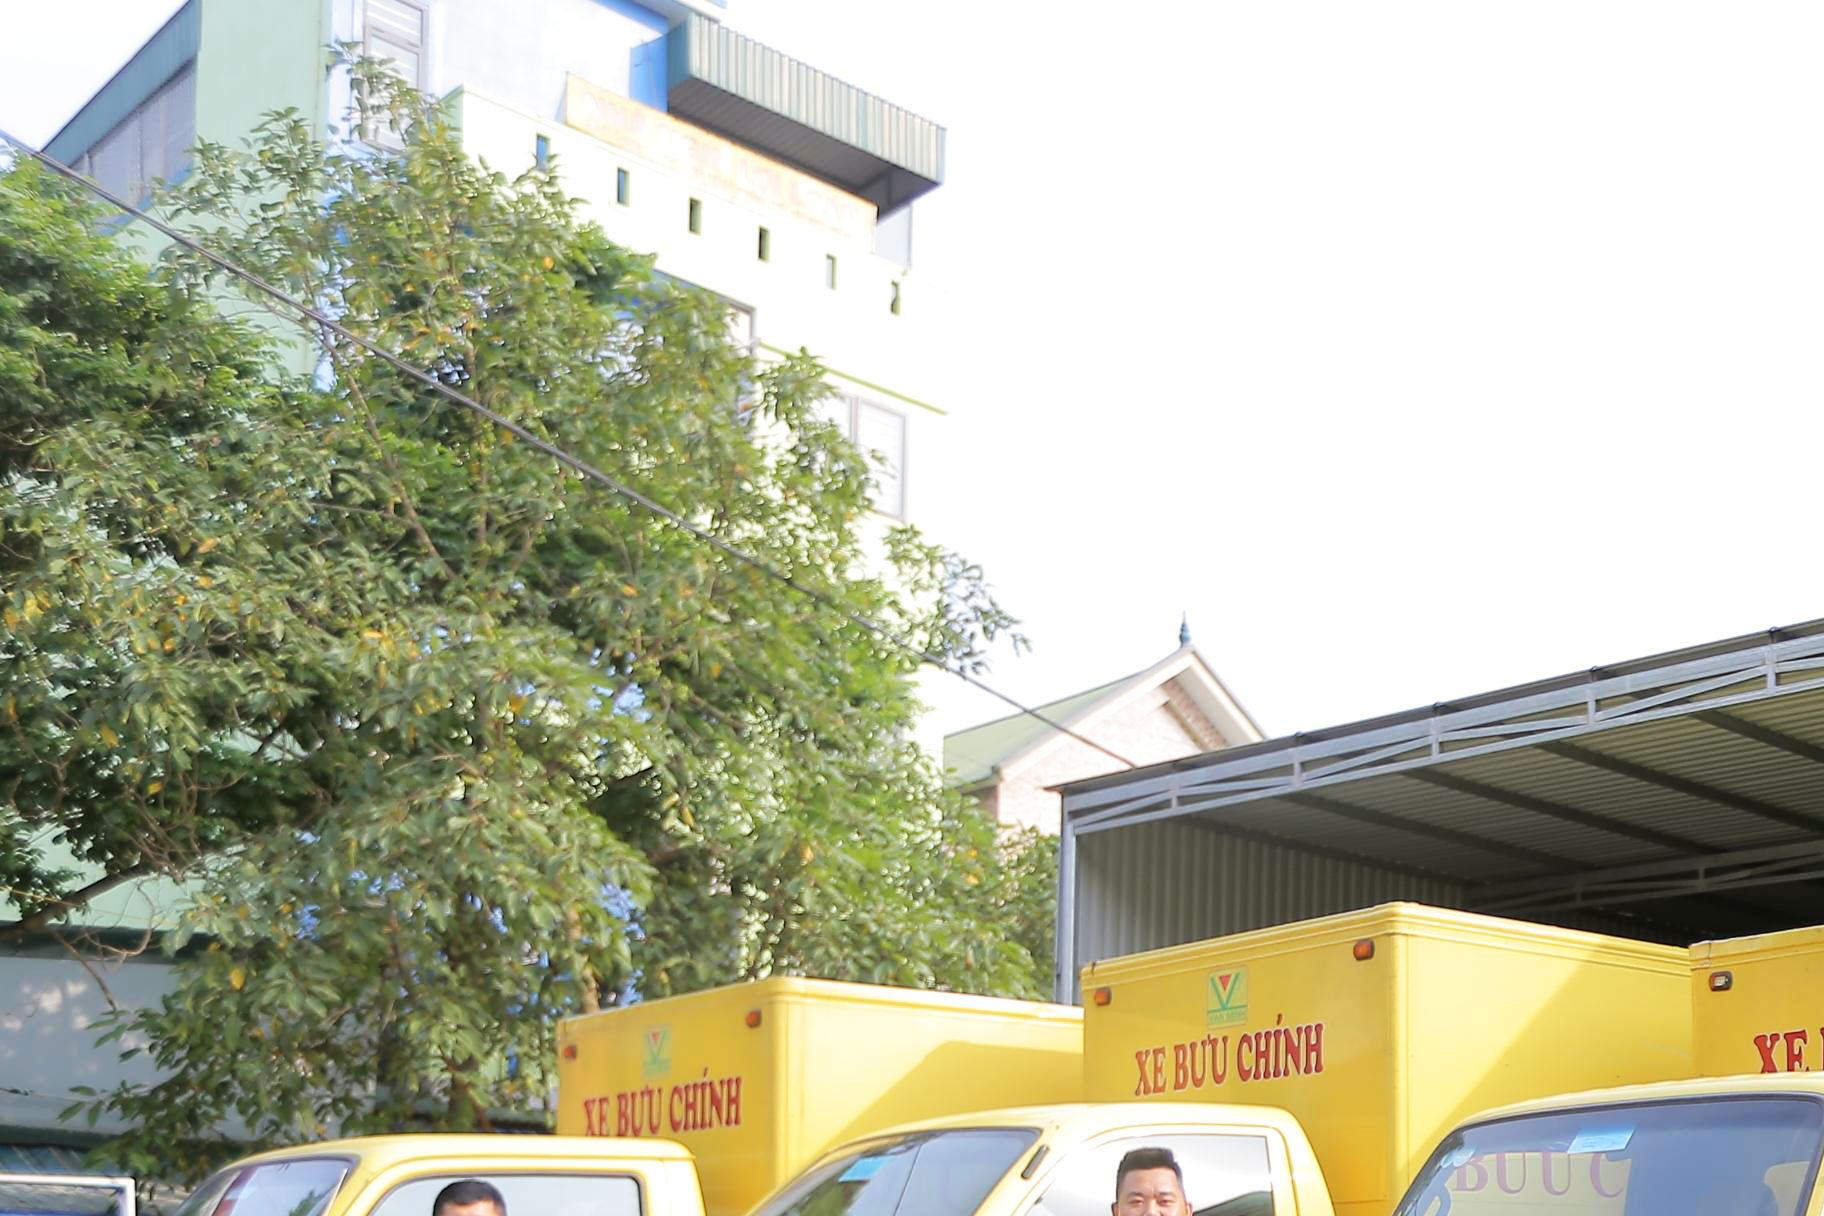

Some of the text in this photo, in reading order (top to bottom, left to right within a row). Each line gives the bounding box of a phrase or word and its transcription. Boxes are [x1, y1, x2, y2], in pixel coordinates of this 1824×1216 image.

[1134, 1013, 1325, 1096] XE BƯU CHÍNH
[1753, 1030, 1810, 1074] XE
[584, 1067, 743, 1137] XE BƯU CHÍNH
